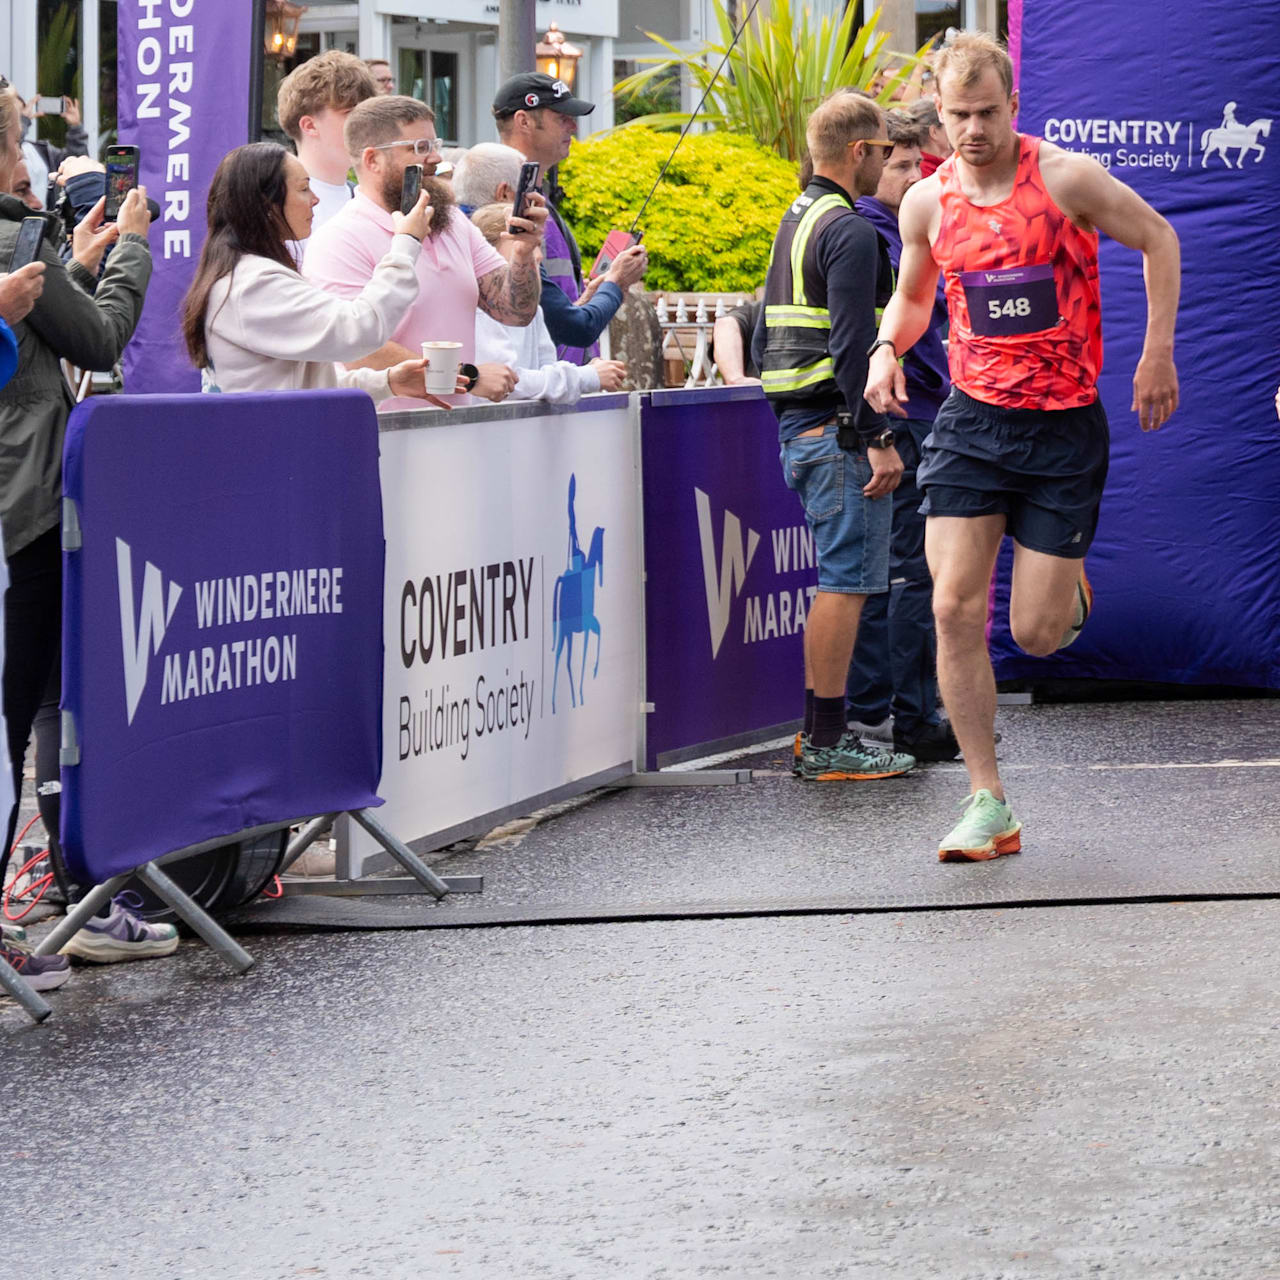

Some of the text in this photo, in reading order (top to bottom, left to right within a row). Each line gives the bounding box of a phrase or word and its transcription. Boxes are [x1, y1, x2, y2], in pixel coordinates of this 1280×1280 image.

[1044, 118, 1182, 145] COVENTRY
[1116, 148, 1181, 172] Society
[988, 297, 1031, 319] 548
[771, 524, 819, 574] WIN
[195, 566, 344, 630] WINDERMERE
[400, 556, 534, 669] COVENTRY
[160, 634, 298, 705] MARATHON
[399, 668, 535, 761] Building Society
